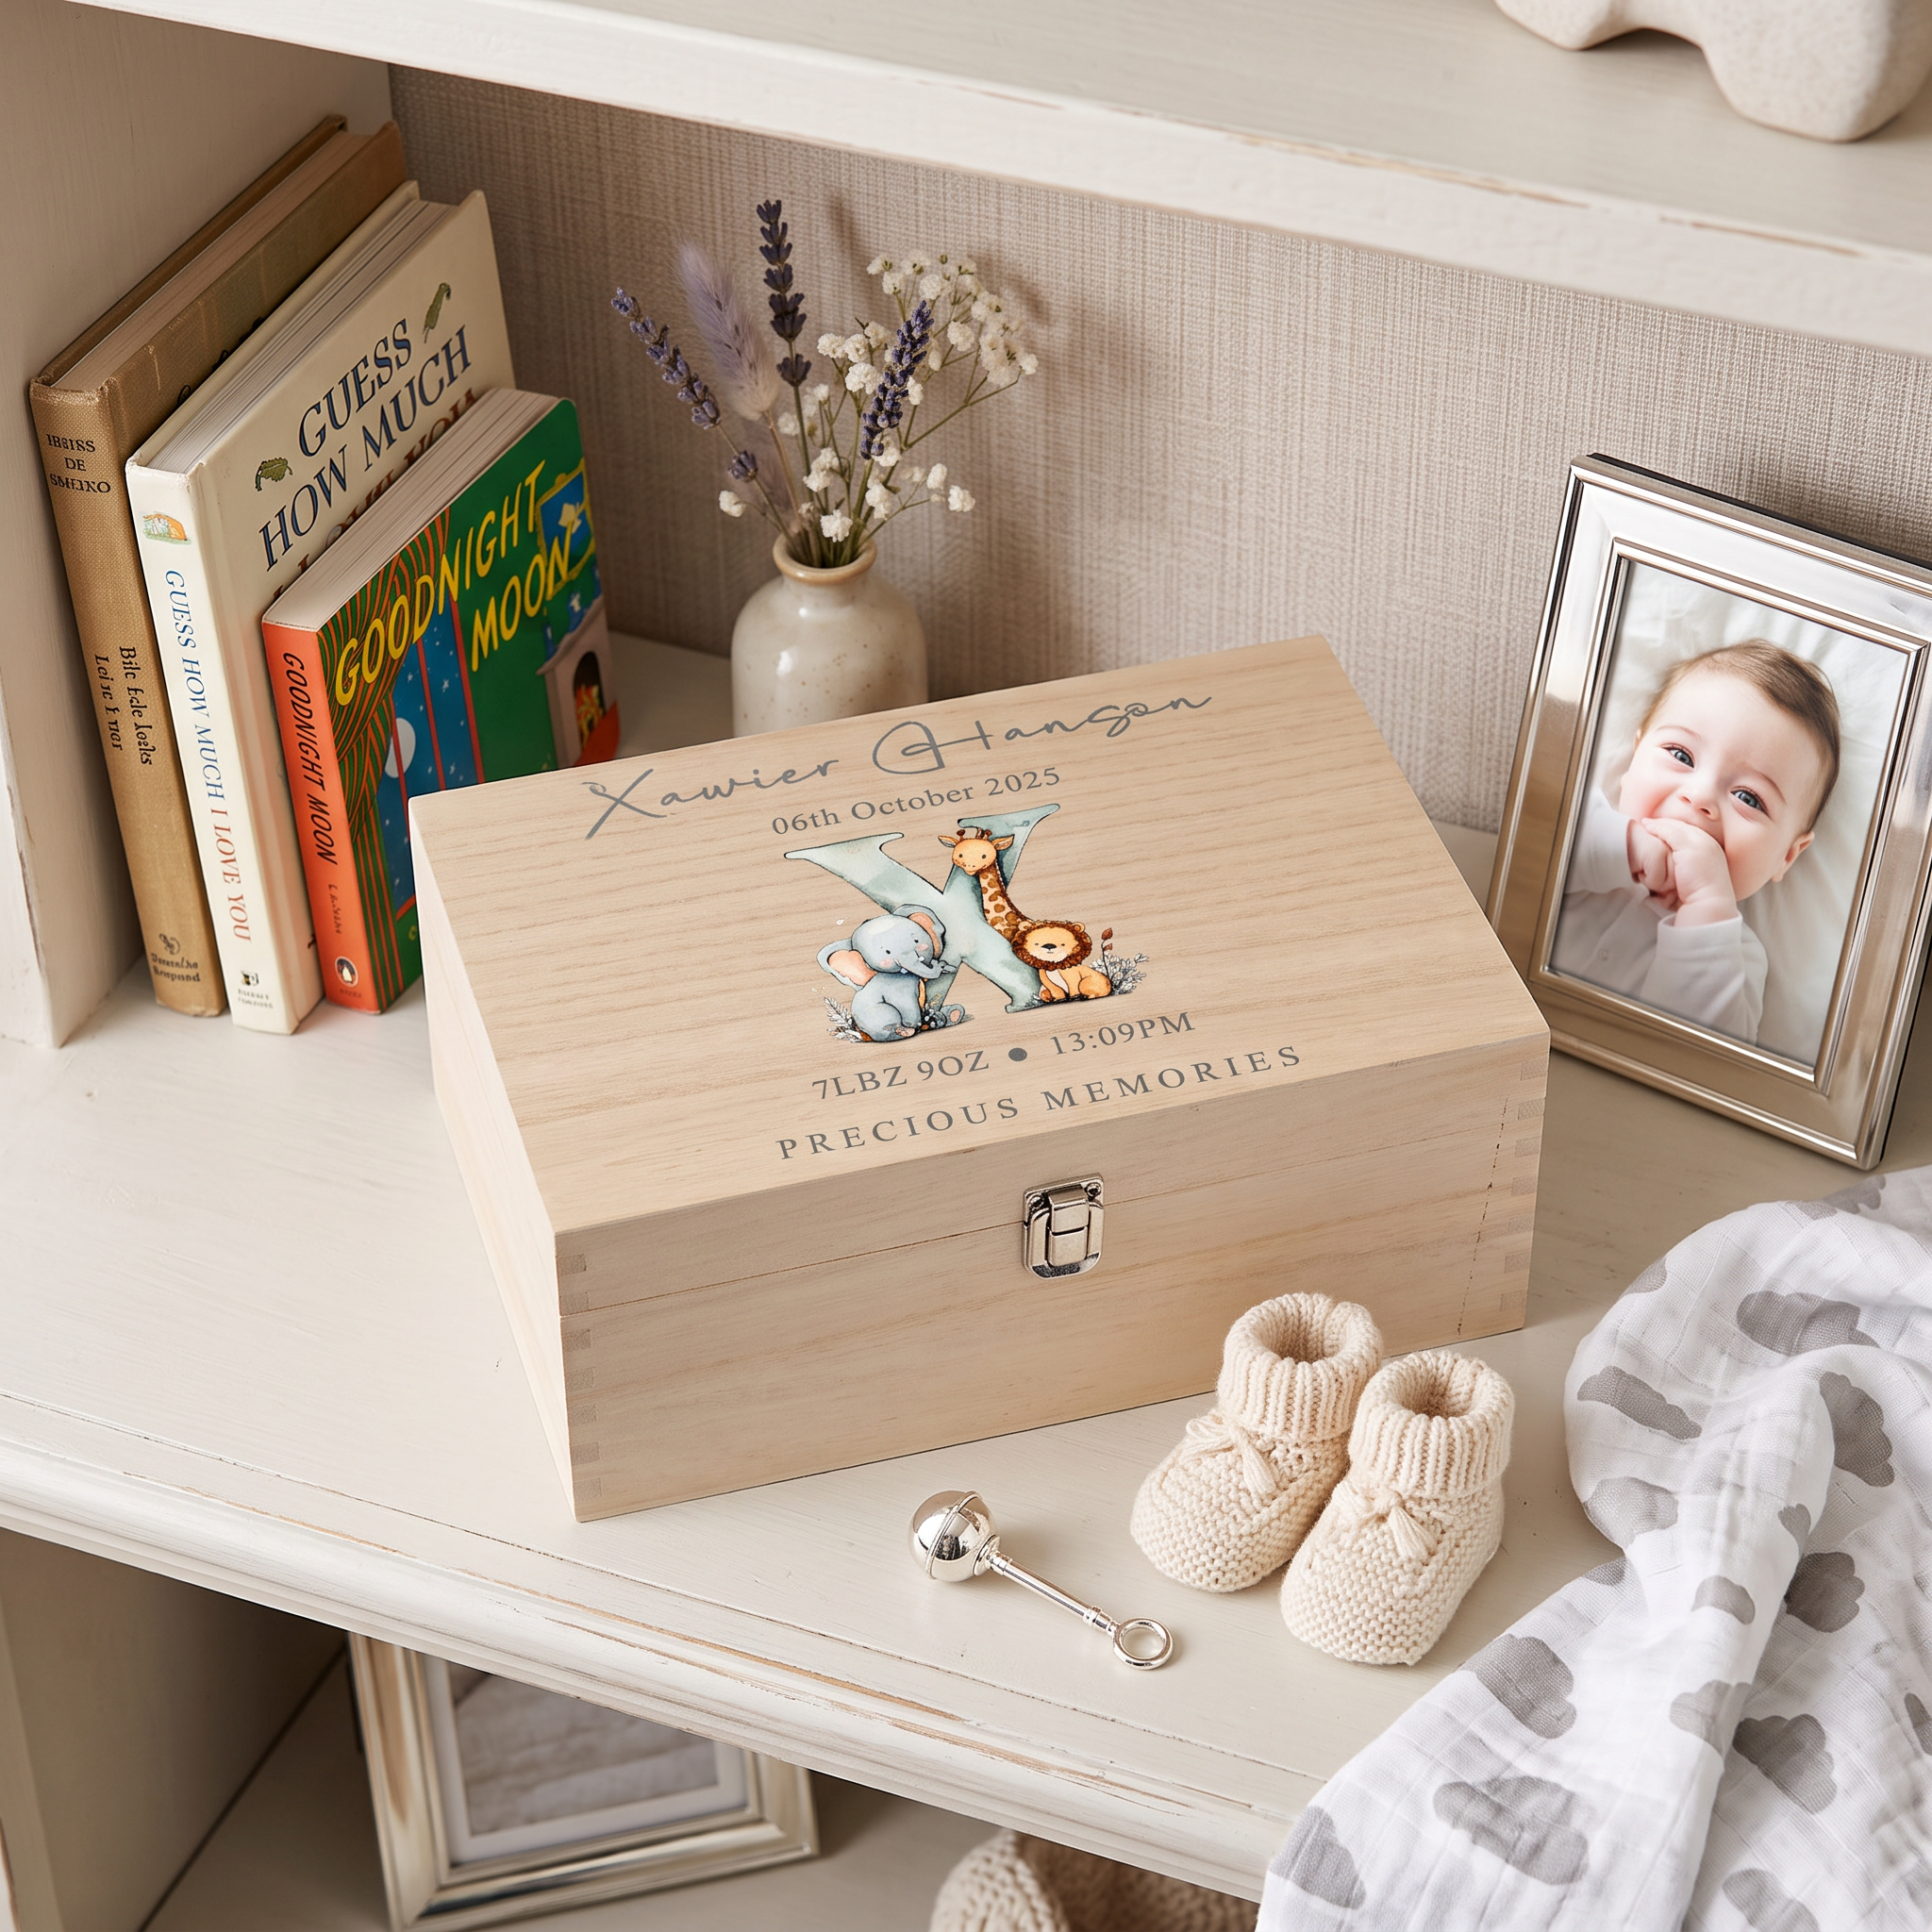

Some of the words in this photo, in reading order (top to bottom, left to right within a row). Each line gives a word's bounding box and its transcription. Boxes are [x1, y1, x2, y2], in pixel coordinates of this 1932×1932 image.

[298, 318, 412, 458] GUESS
[258, 443, 348, 572] HOW
[361, 324, 472, 472] MUCH
[165, 570, 197, 650] GUESS
[335, 459, 545, 707] GOODNIGHT
[472, 526, 573, 672] MOON
[182, 657, 211, 719] HOW
[194, 724, 226, 802] MUCH
[283, 652, 326, 791] GOODNIGHT
[307, 792, 338, 865] MOON
[772, 807, 841, 835] 06th
[850, 783, 974, 821] October
[984, 766, 1061, 797] 2025
[210, 807, 228, 817] I
[213, 822, 242, 886] LOVE
[226, 891, 253, 942] YOU
[811, 1064, 908, 1101] 7LBZ
[1050, 1010, 1197, 1056] 13:09PM
[775, 1095, 1020, 1161] PRECIOUS
[1040, 1044, 1302, 1111] MEMORIES
